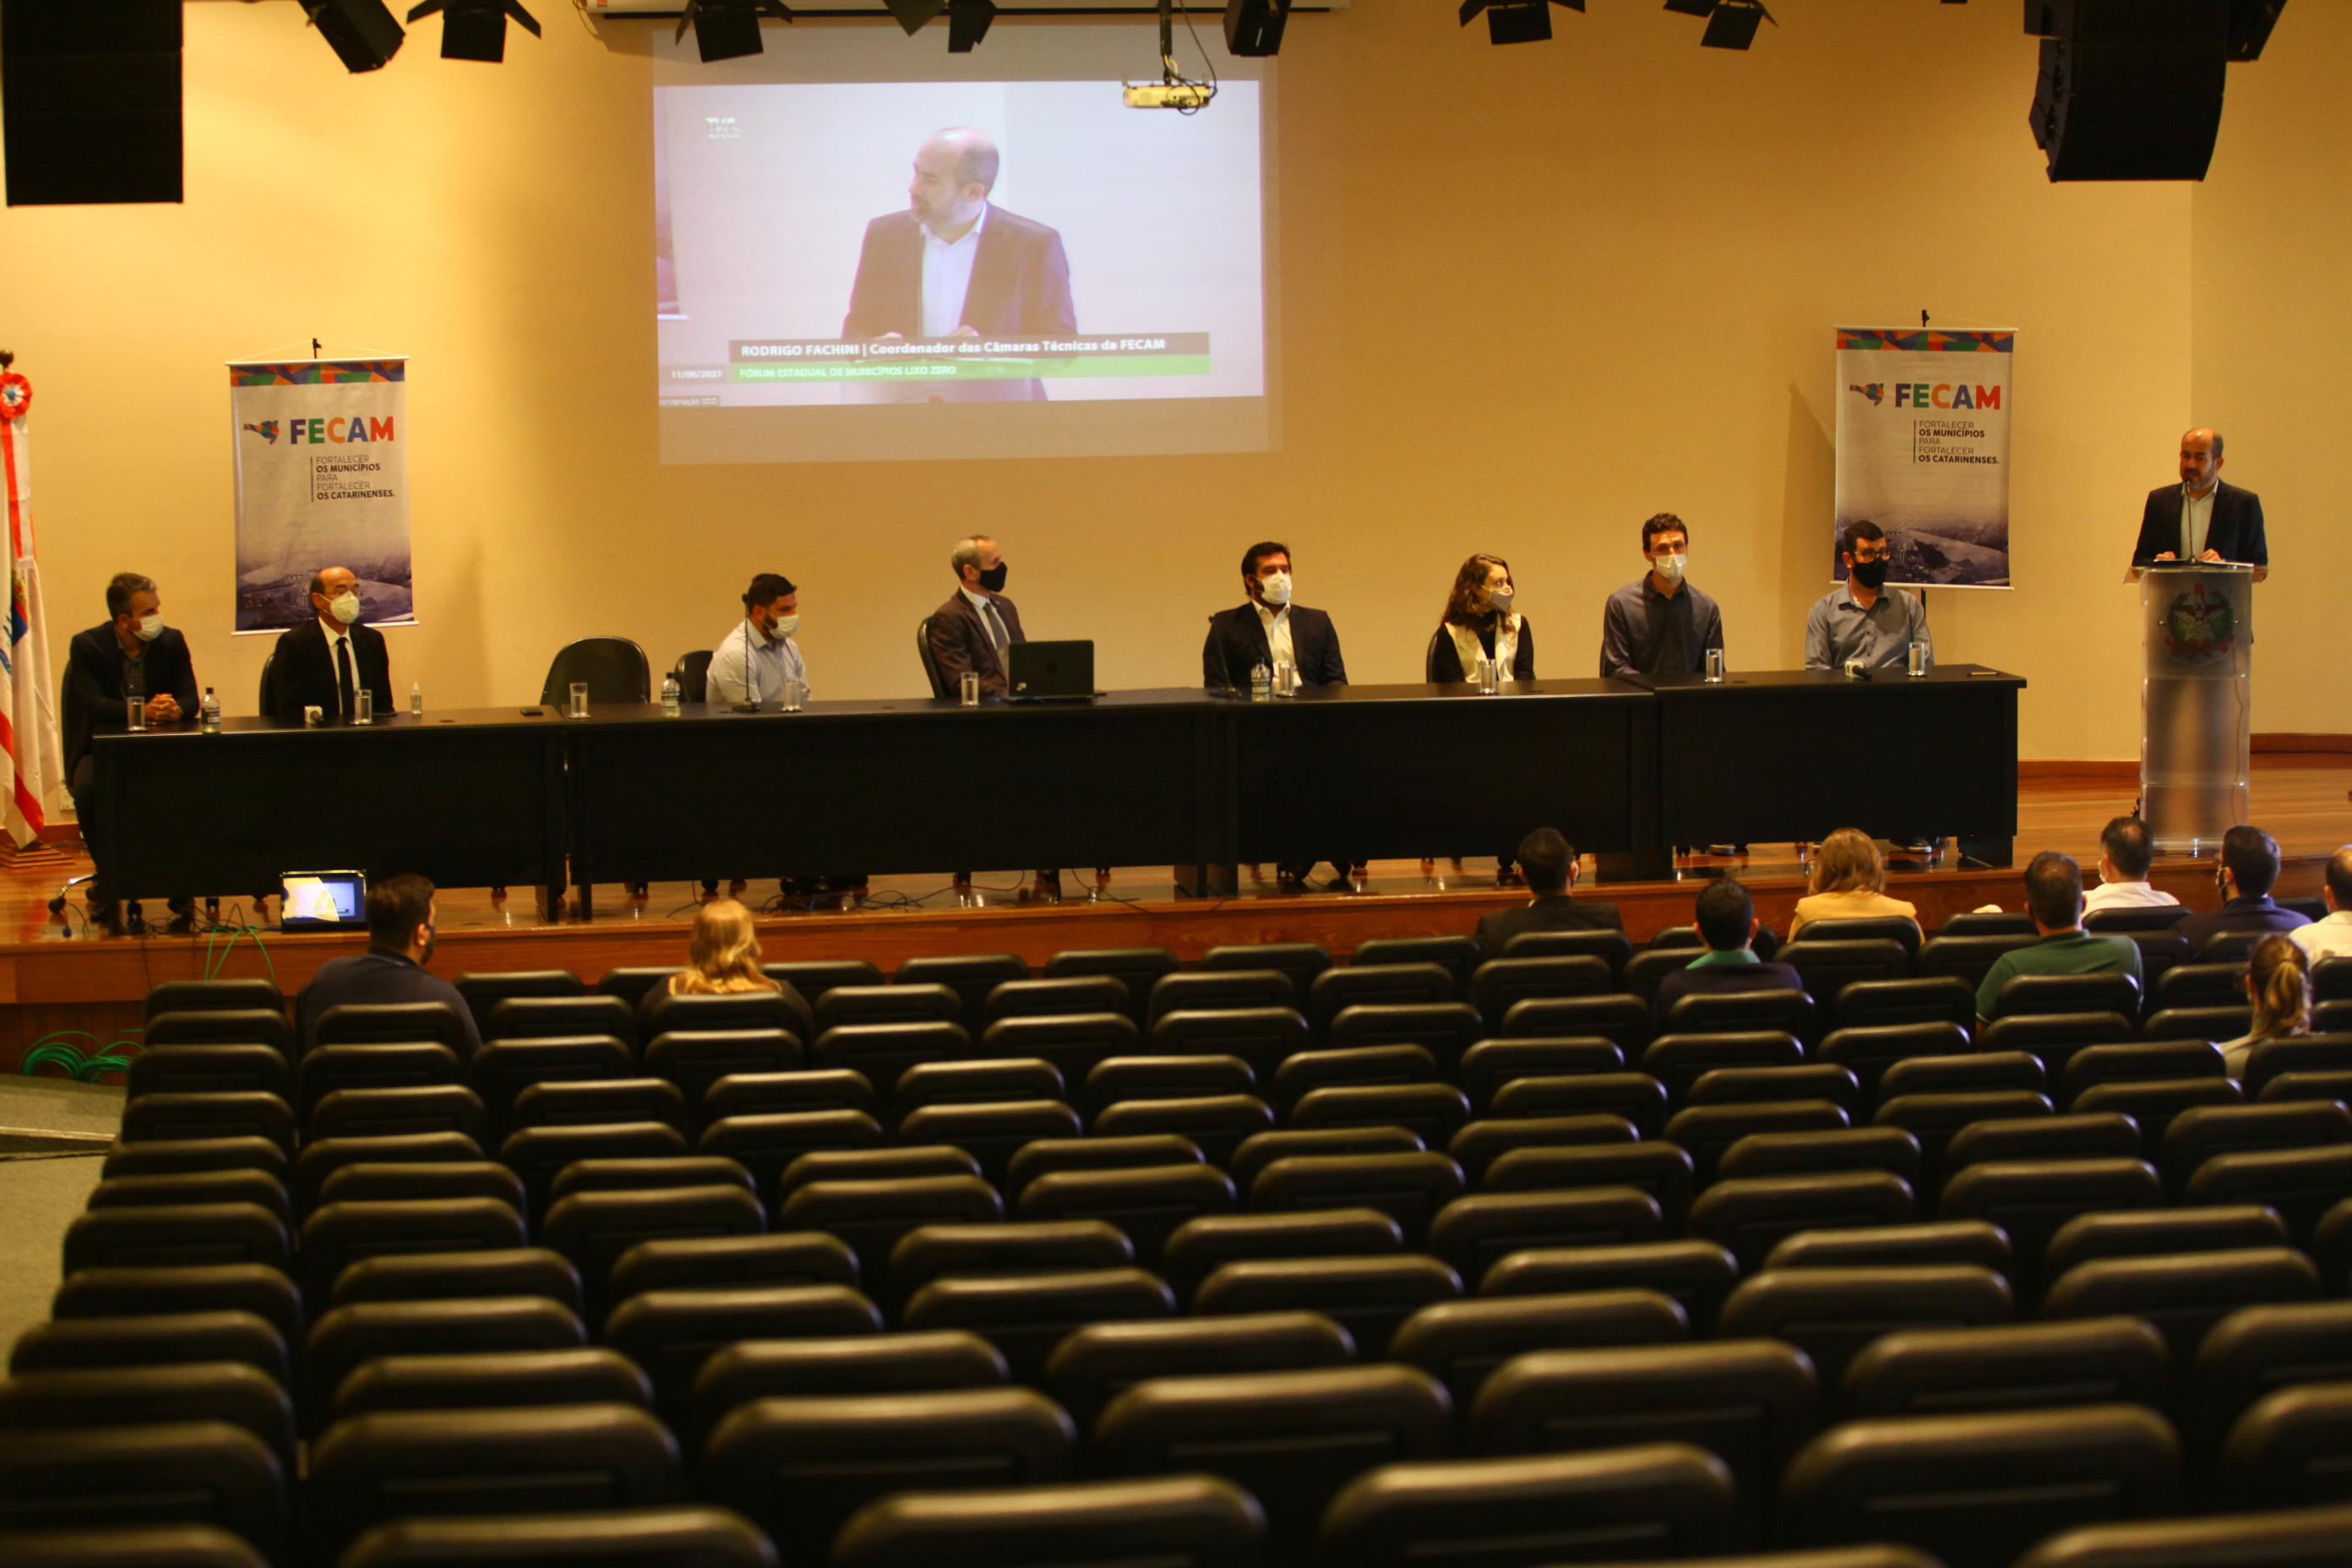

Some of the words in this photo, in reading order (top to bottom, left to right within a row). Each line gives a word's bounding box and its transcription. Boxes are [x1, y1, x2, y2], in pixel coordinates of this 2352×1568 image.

[741, 346, 802, 356] RODRIGO
[806, 344, 859, 355] FACHINI
[869, 342, 956, 354] Coordenador
[958, 342, 981, 352] das
[983, 341, 1040, 351] Câmaras
[1042, 340, 1097, 351] Técnicas
[1101, 340, 1118, 350] da
[1120, 339, 1165, 350] FECAM
[671, 370, 722, 378] 11/06/2021
[739, 368, 775, 378] FÓRUM
[776, 368, 827, 377] ESTADUAL
[830, 367, 844, 376] DE
[846, 365, 902, 376] MUNICÍPIOS
[905, 366, 928, 374] LIXO
[930, 365, 956, 374] ZERO
[1895, 383, 2001, 410] FECAM
[1919, 420, 1974, 428] FORTALECER
[290, 416, 395, 444] FECAM
[1933, 429, 1984, 438] MUNICÍPIOS
[1919, 446, 1974, 455] FORTALECER
[316, 455, 369, 464] FORTALECER
[1933, 455, 2000, 464] CATARINENSES.
[330, 463, 380, 472] MUNICÍPIOS
[317, 482, 371, 491] FORTALECER
[331, 489, 395, 499] CATARINENSES.
